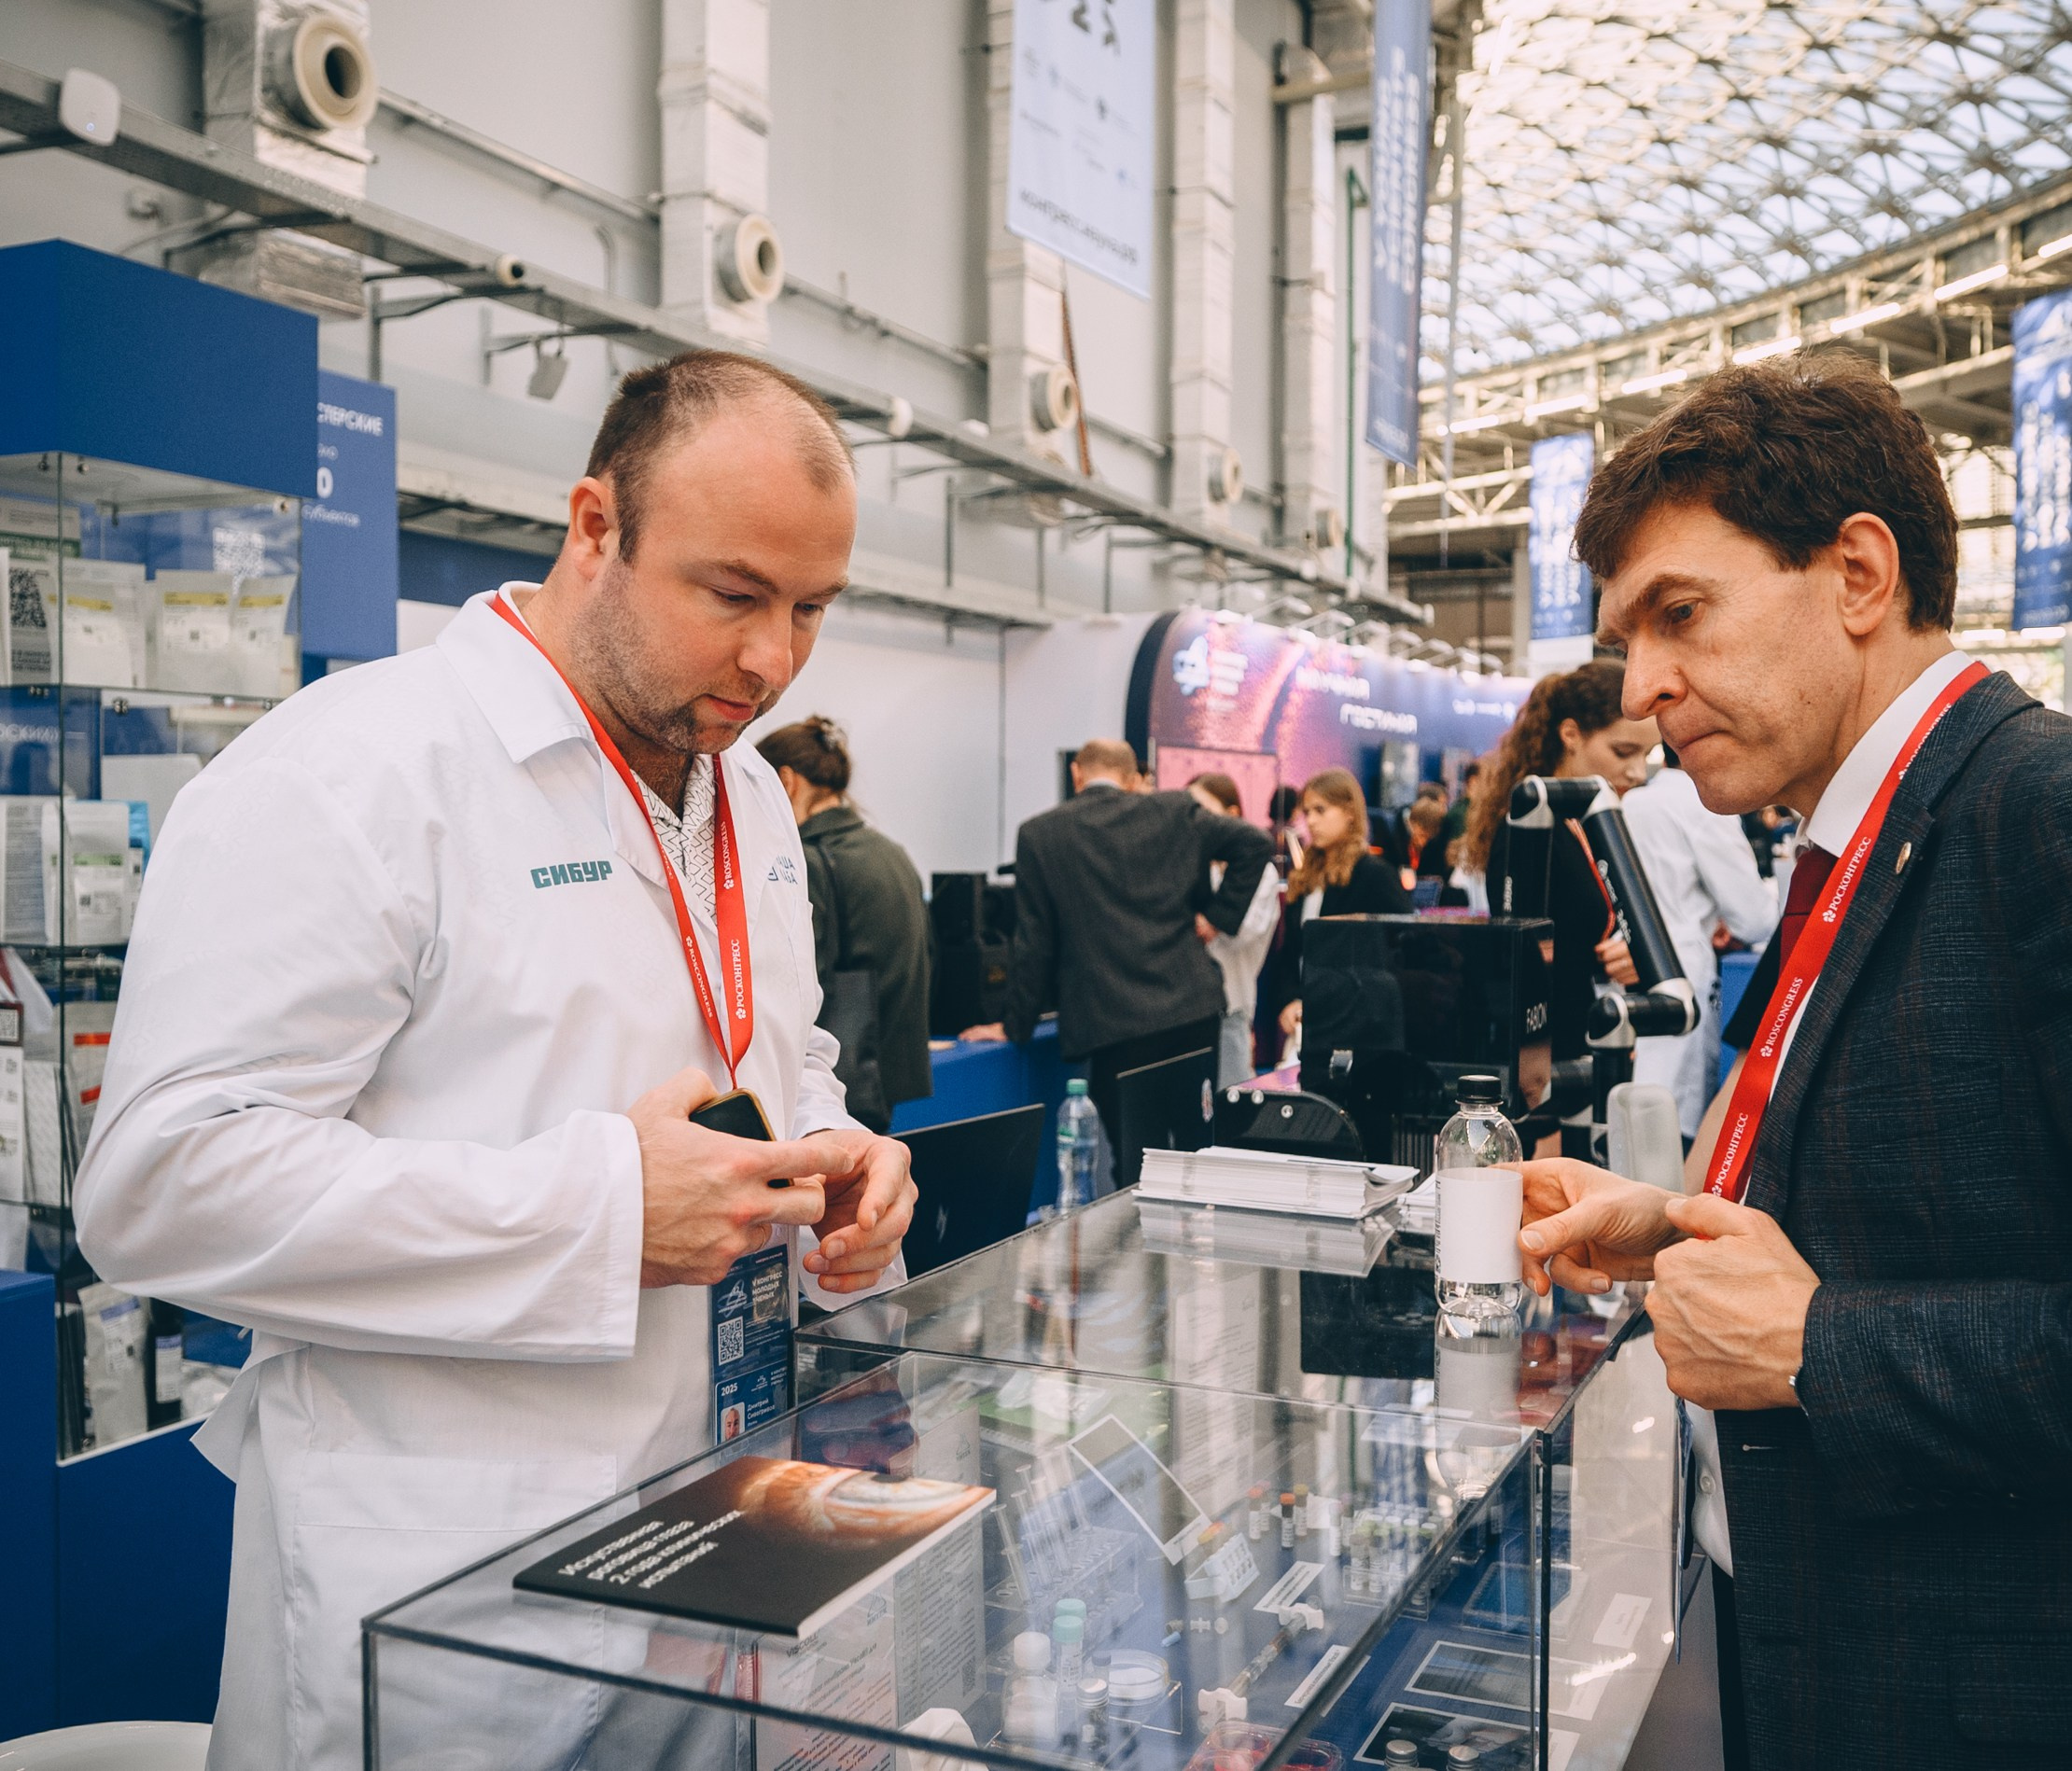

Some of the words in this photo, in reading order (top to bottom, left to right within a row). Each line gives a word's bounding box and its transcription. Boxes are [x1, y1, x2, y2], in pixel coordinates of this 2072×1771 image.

[530, 860, 613, 889] СИБУР
[721, 820, 734, 880] ROSCONGRESS
[1829, 837, 1871, 911] РОСКОНГРЕСС
[689, 946, 714, 1017] ROSCONGRESS
[731, 939, 745, 1008] РОСКОНГРЕСС
[1766, 977, 1803, 1046] ROSCONGRESS
[1715, 1112, 1748, 1186] РОСКОНГРЕСС
[721, 1383, 737, 1397] 2025
[609, 1573, 631, 1584] 2
